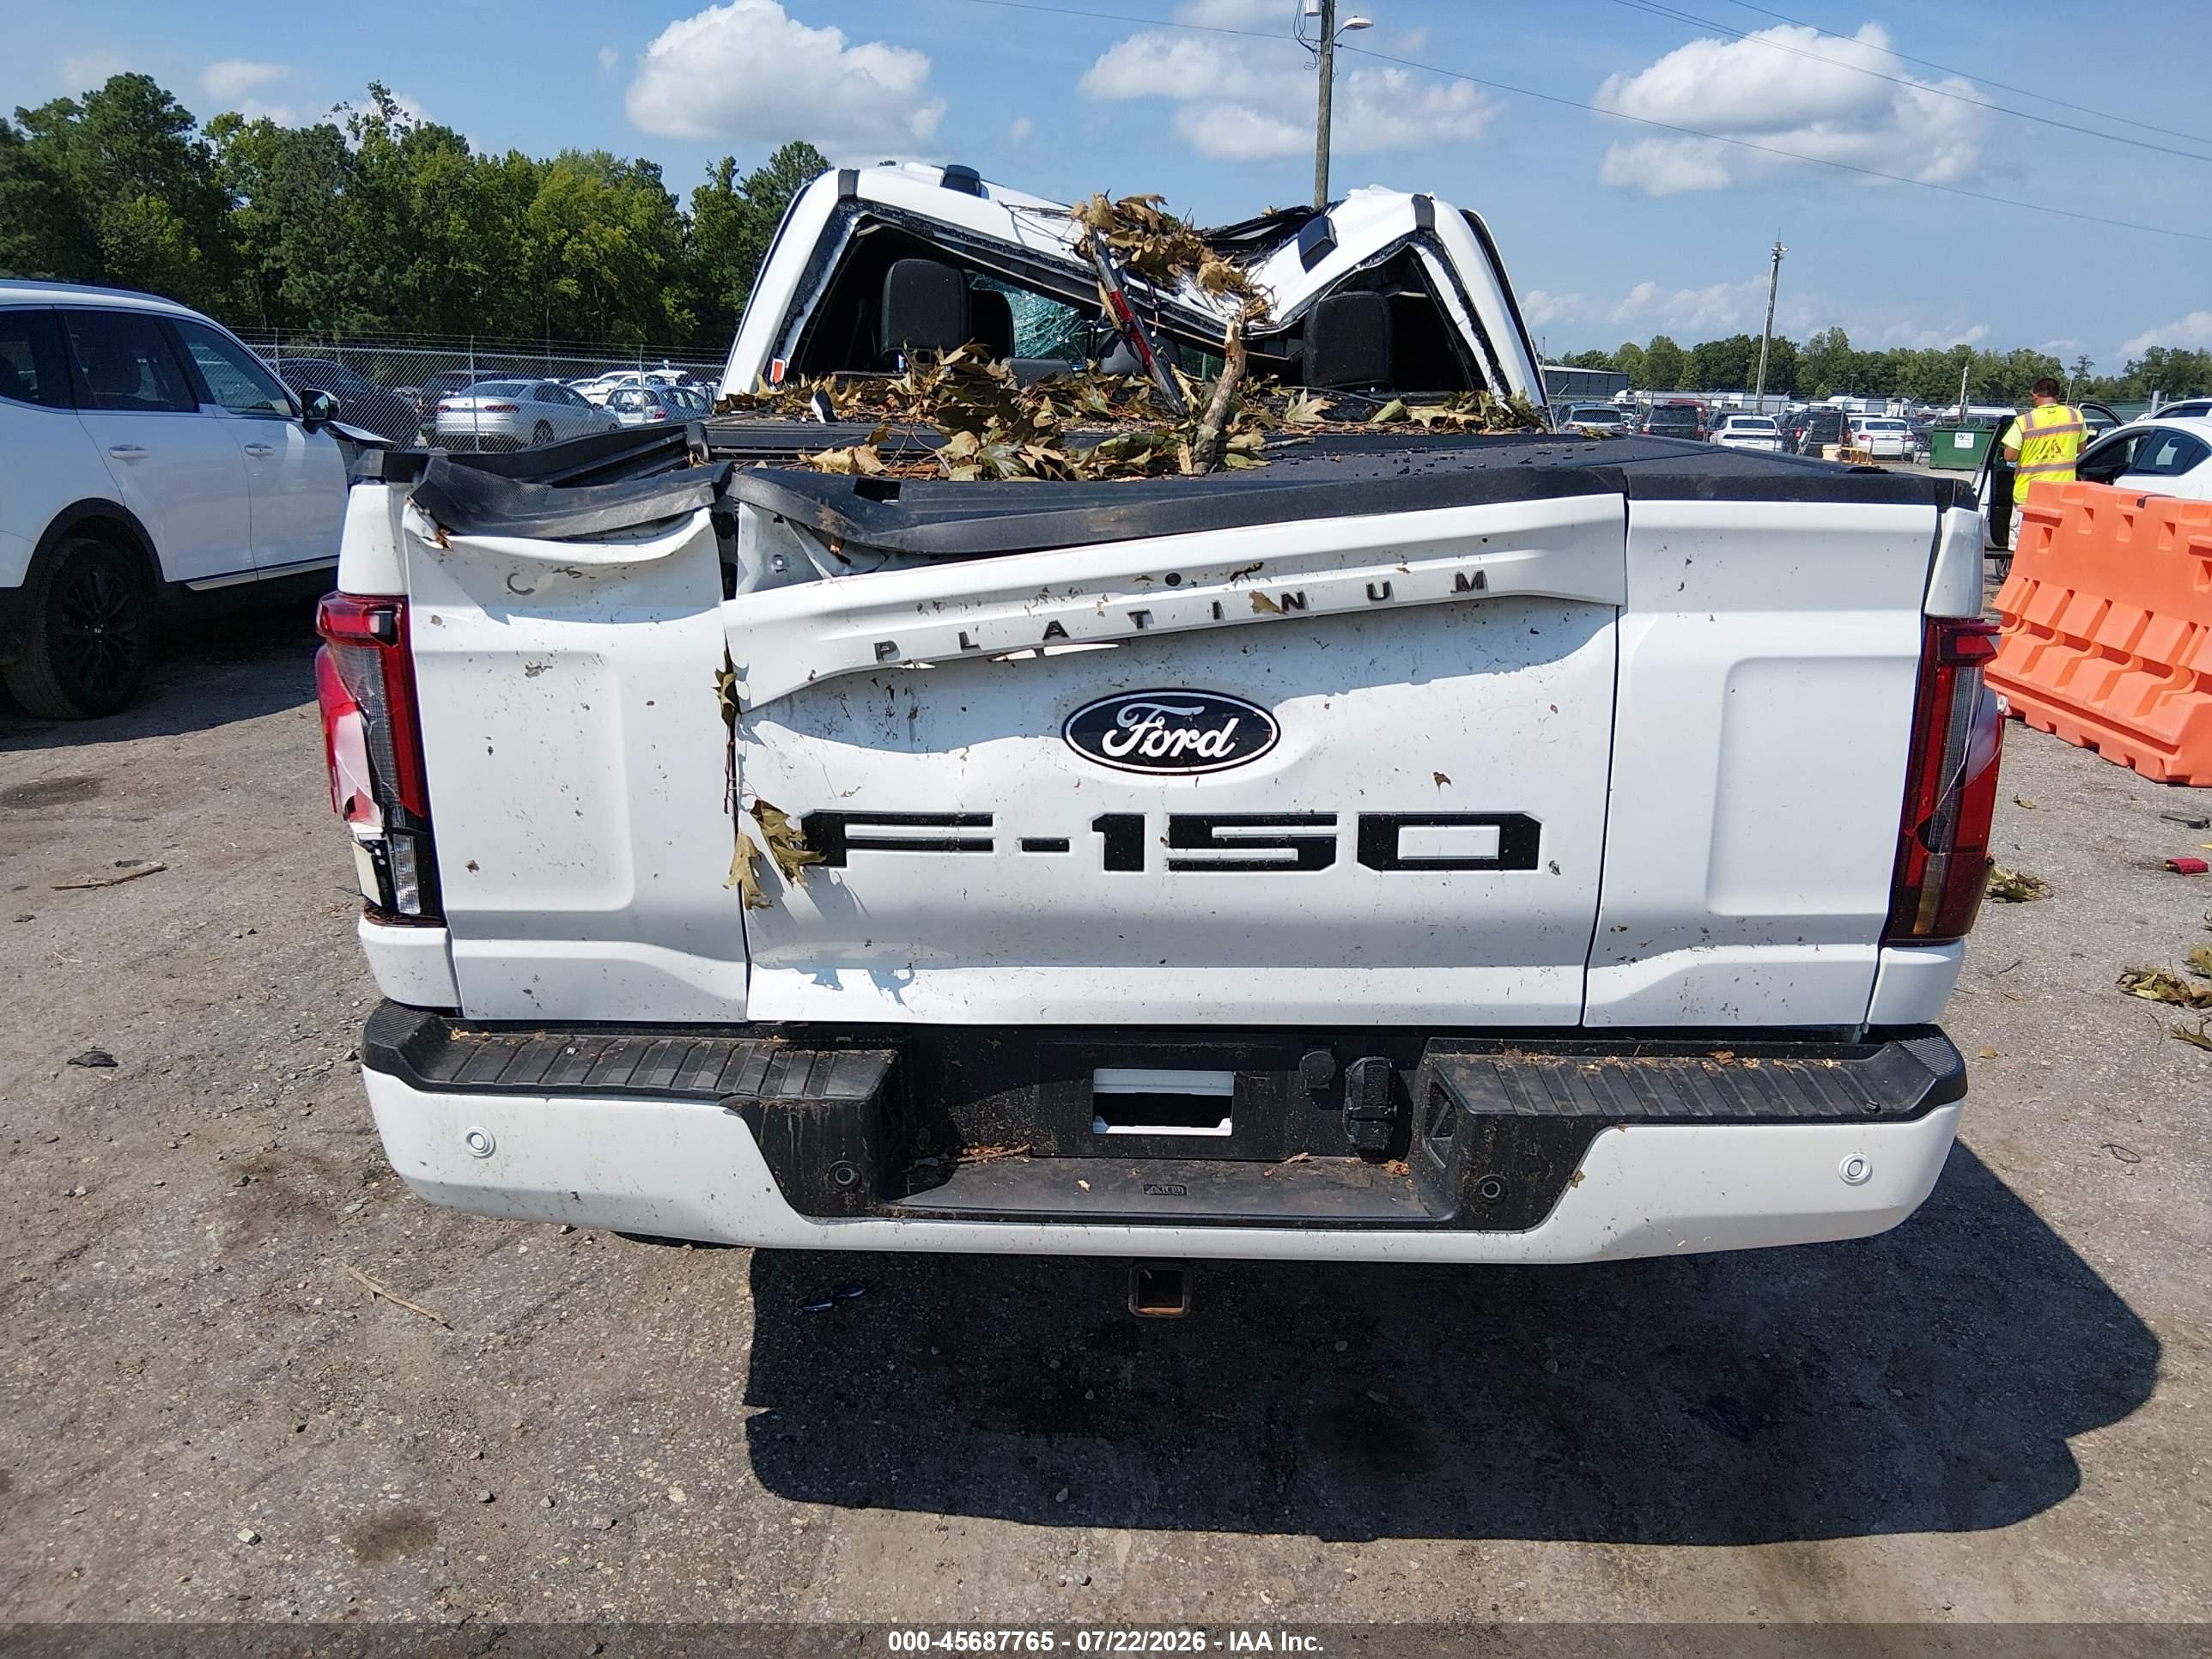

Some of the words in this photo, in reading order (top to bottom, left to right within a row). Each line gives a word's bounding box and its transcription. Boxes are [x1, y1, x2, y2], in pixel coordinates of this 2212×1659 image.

[873, 569, 1486, 661] PLATINUM
[1102, 702, 1239, 758] Ford
[800, 810, 1541, 871] F-150
